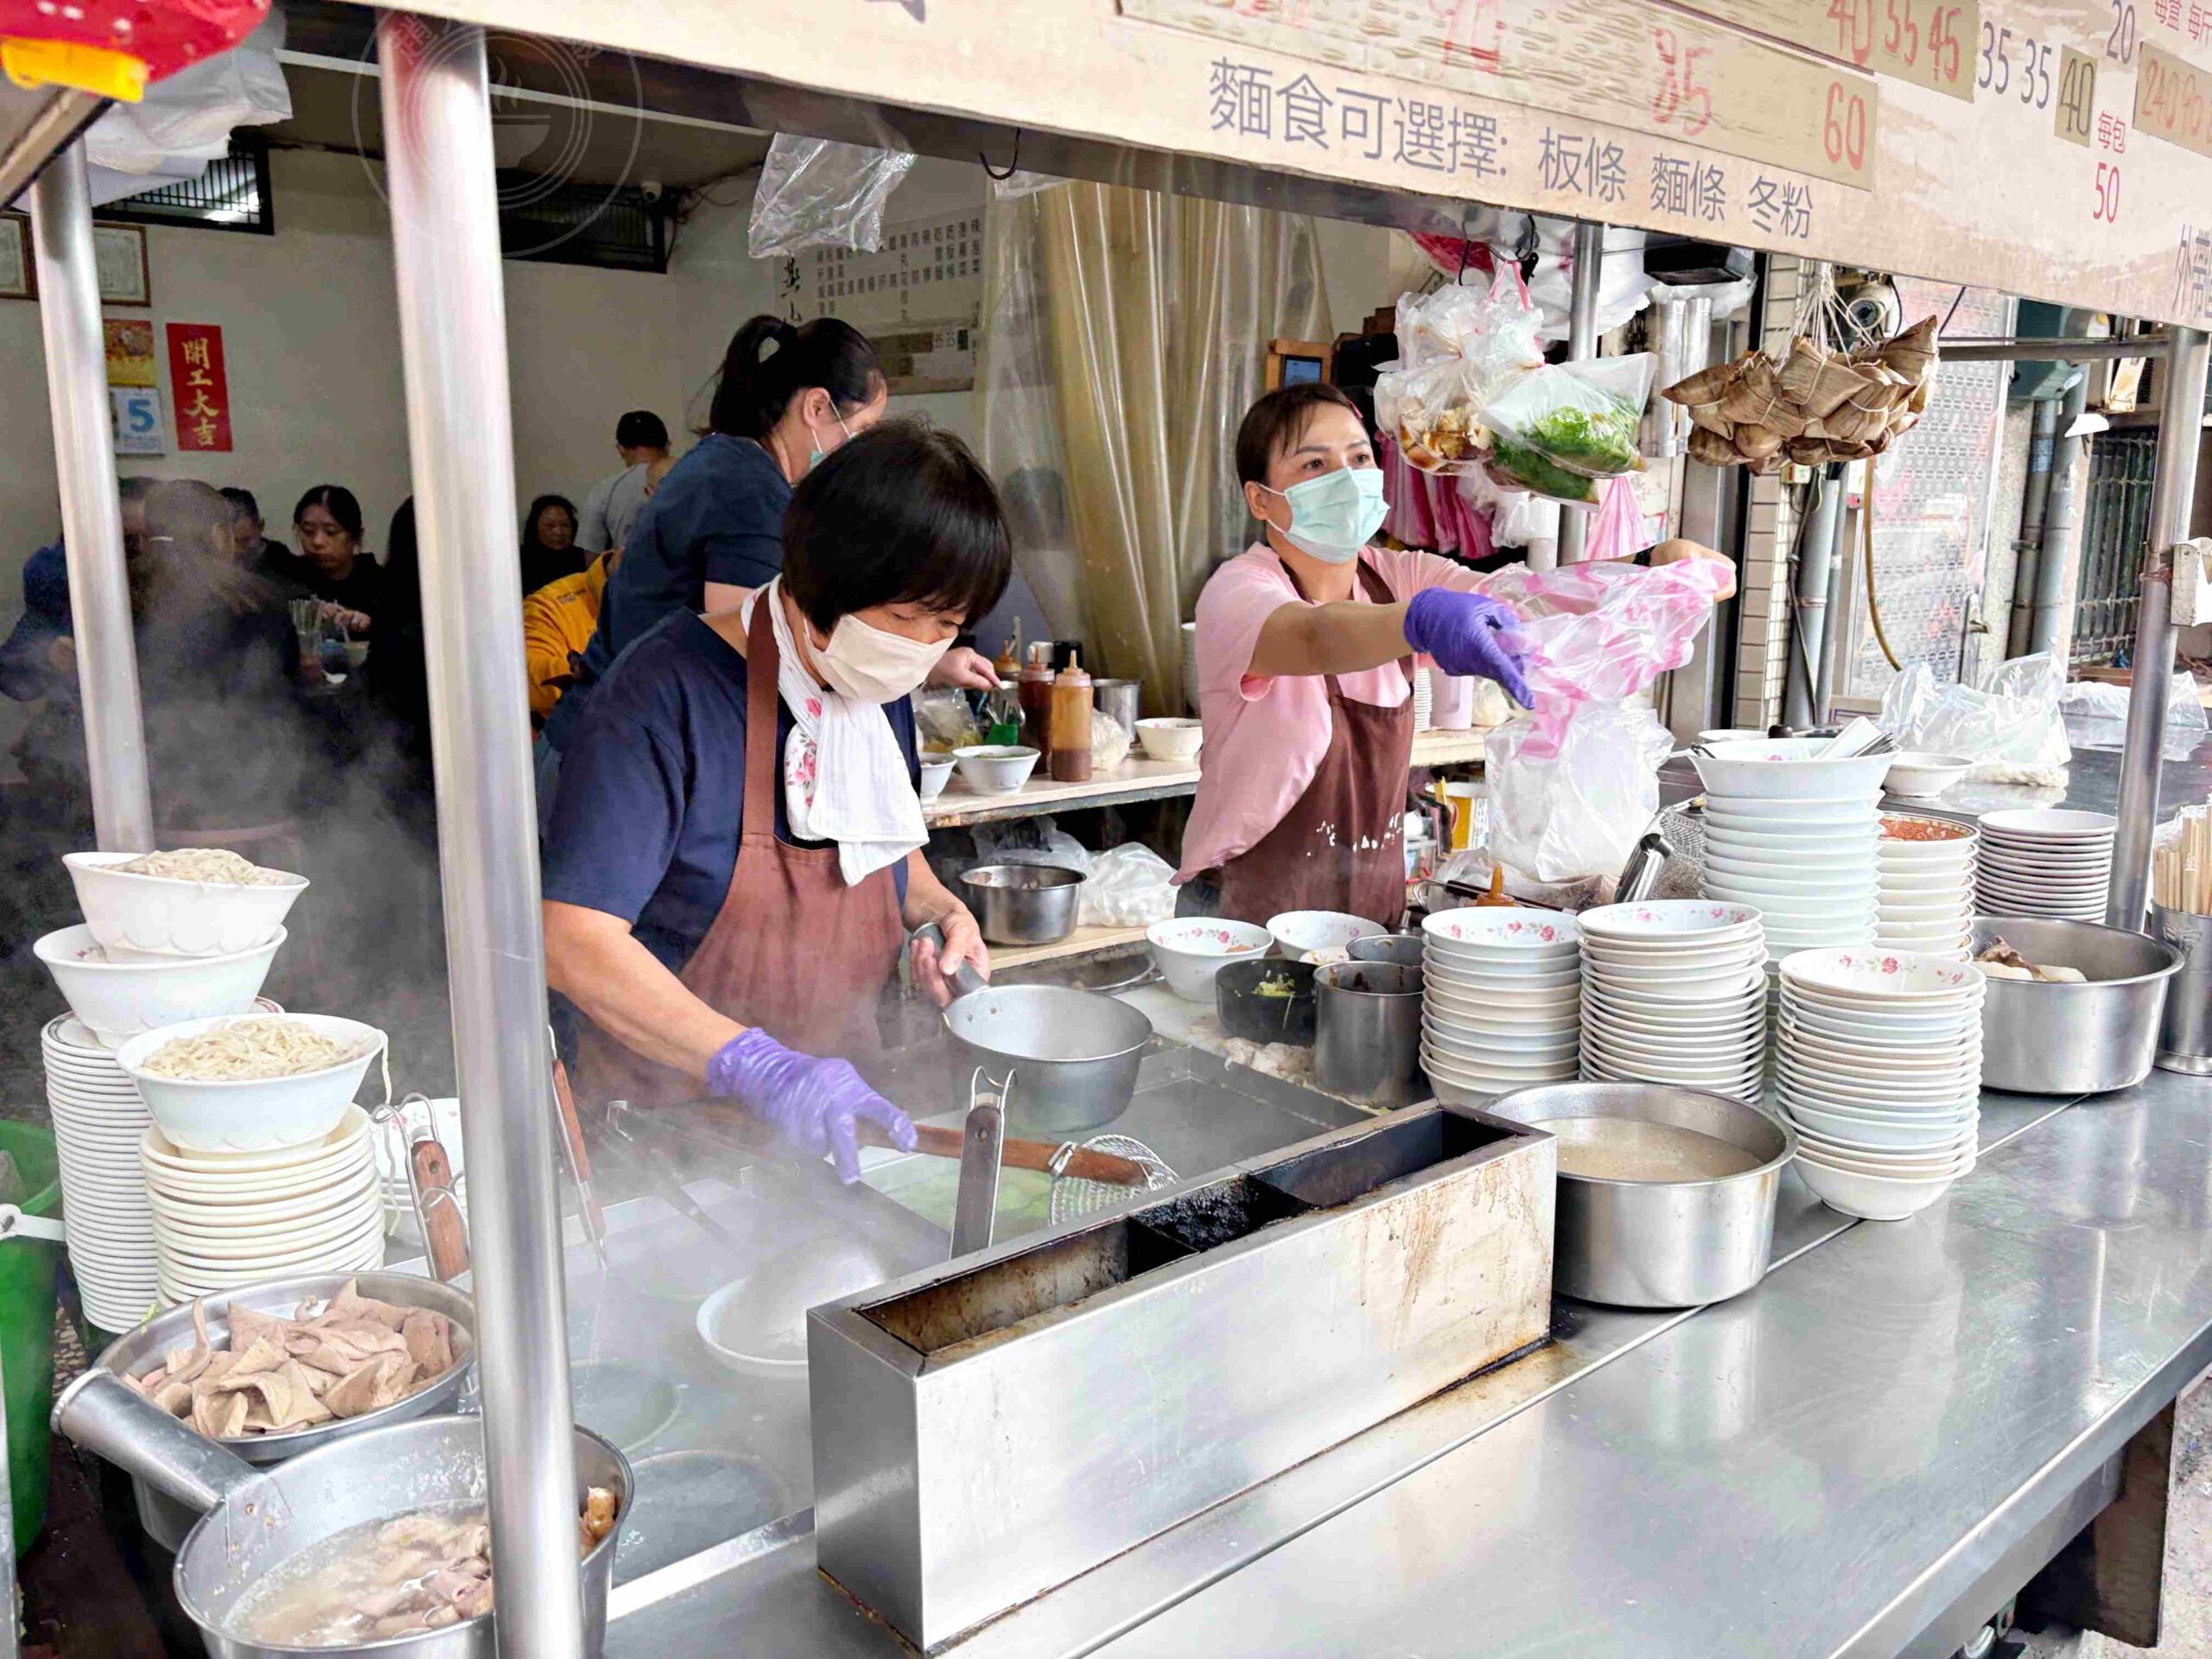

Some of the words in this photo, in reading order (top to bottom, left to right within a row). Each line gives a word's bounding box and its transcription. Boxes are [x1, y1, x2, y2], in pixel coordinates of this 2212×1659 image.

[1927, 5, 1962, 83] 45
[2107, 0, 2135, 65] 20
[1649, 28, 1713, 136] 85
[1978, 20, 2012, 95] 35
[2020, 38, 2052, 110] 35
[2060, 58, 2095, 137] 40
[1209, 55, 1509, 179] 麵食可選擇:
[1537, 126, 1627, 203] 板條
[1649, 152, 1726, 221] 麵條
[1746, 175, 1814, 239] 冬粉
[1823, 80, 1866, 171] 60
[2097, 110, 2126, 155] 每包
[2092, 161, 2120, 224] 50
[128, 397, 156, 434] 5
[181, 336, 220, 448] 開工大吉
